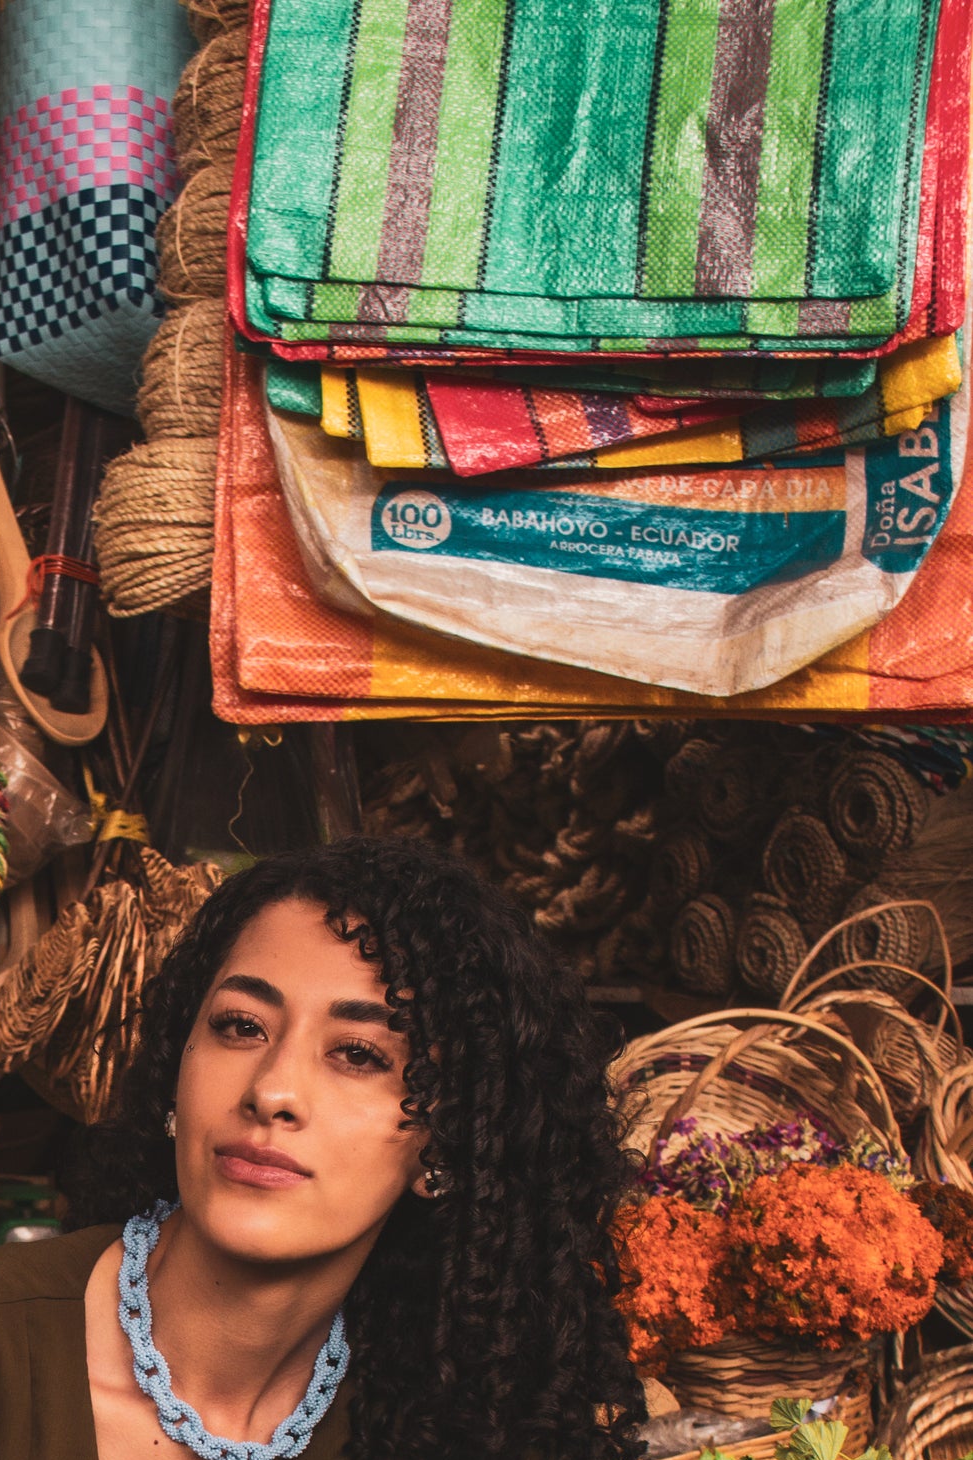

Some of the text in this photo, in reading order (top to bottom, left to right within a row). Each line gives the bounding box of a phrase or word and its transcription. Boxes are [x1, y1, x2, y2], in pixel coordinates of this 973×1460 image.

[659, 474, 694, 496] DE
[702, 477, 777, 501] CADA
[785, 478, 832, 500] DIA
[387, 503, 443, 528] 100
[870, 479, 897, 548] Doña
[391, 524, 442, 542] Lbrs.
[481, 507, 608, 539] BABAHOYO
[630, 525, 741, 553] ECUADOR
[549, 540, 626, 558] ARROCERA
